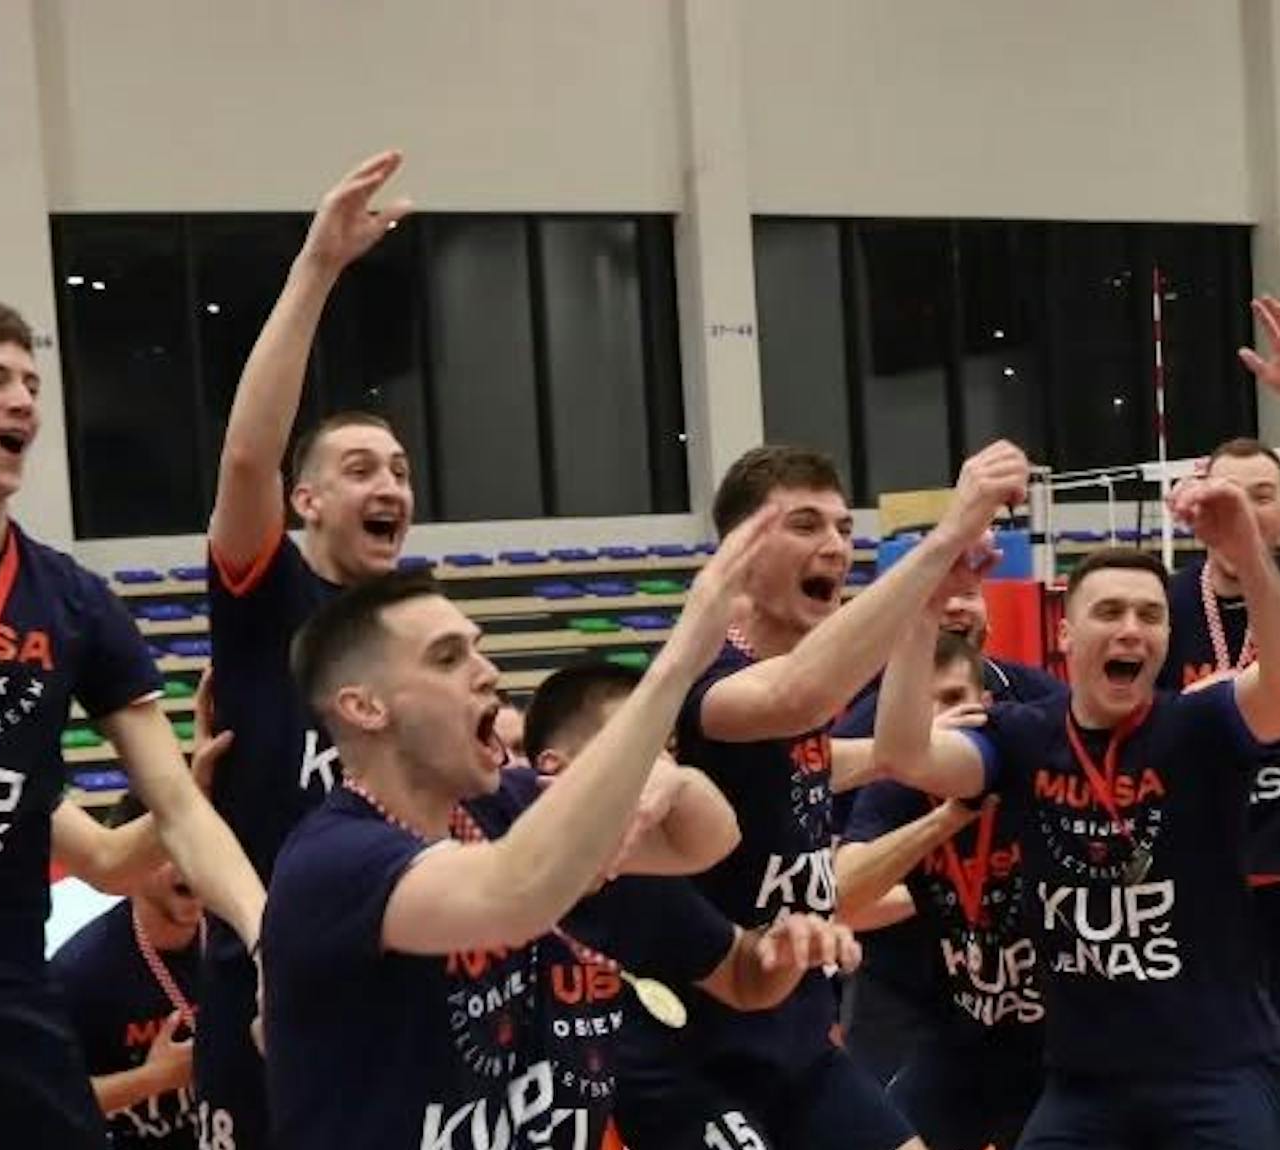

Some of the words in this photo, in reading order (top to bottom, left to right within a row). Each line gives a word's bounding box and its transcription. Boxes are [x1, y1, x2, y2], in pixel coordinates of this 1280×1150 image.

[1034, 768, 1166, 808] MUSA
[1038, 879, 1175, 941] KUP
[1075, 921, 1182, 980] NAŠ
